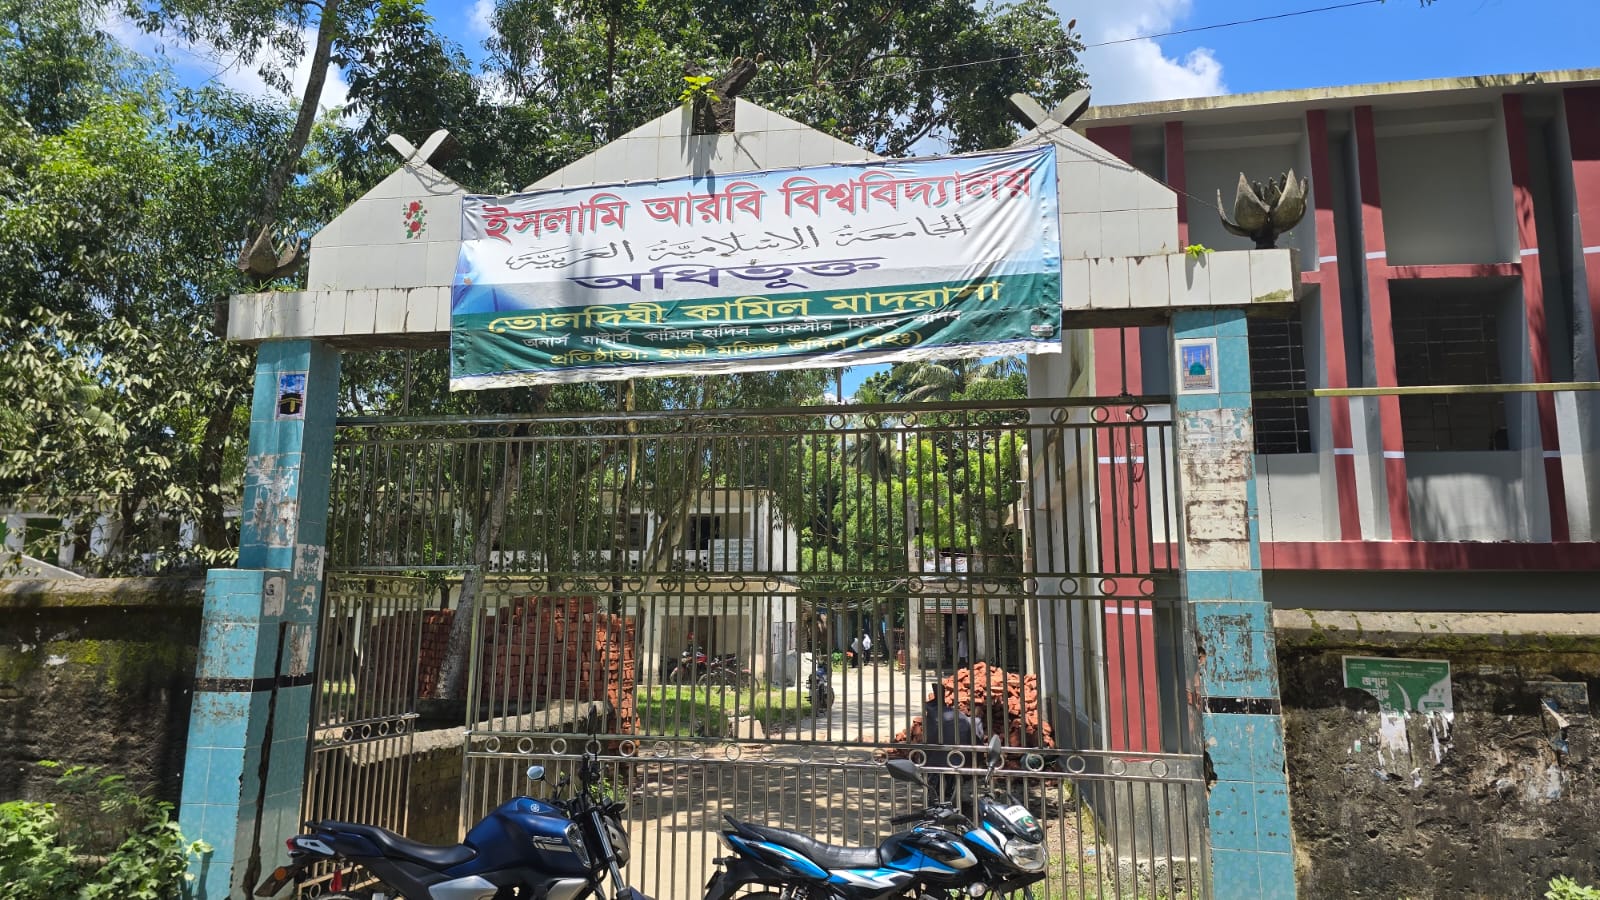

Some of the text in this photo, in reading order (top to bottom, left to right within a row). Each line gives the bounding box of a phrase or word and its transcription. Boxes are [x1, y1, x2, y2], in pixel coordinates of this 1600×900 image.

[481, 167, 1035, 244] ইসলামি আরবি বিশ্ববিদ্যালয়
[680, 295, 812, 323] কামিল
[521, 332, 570, 349] অনার্স
[643, 326, 695, 342] কামিল
[701, 323, 751, 340] হাদিস
[658, 343, 707, 360] হাজী
